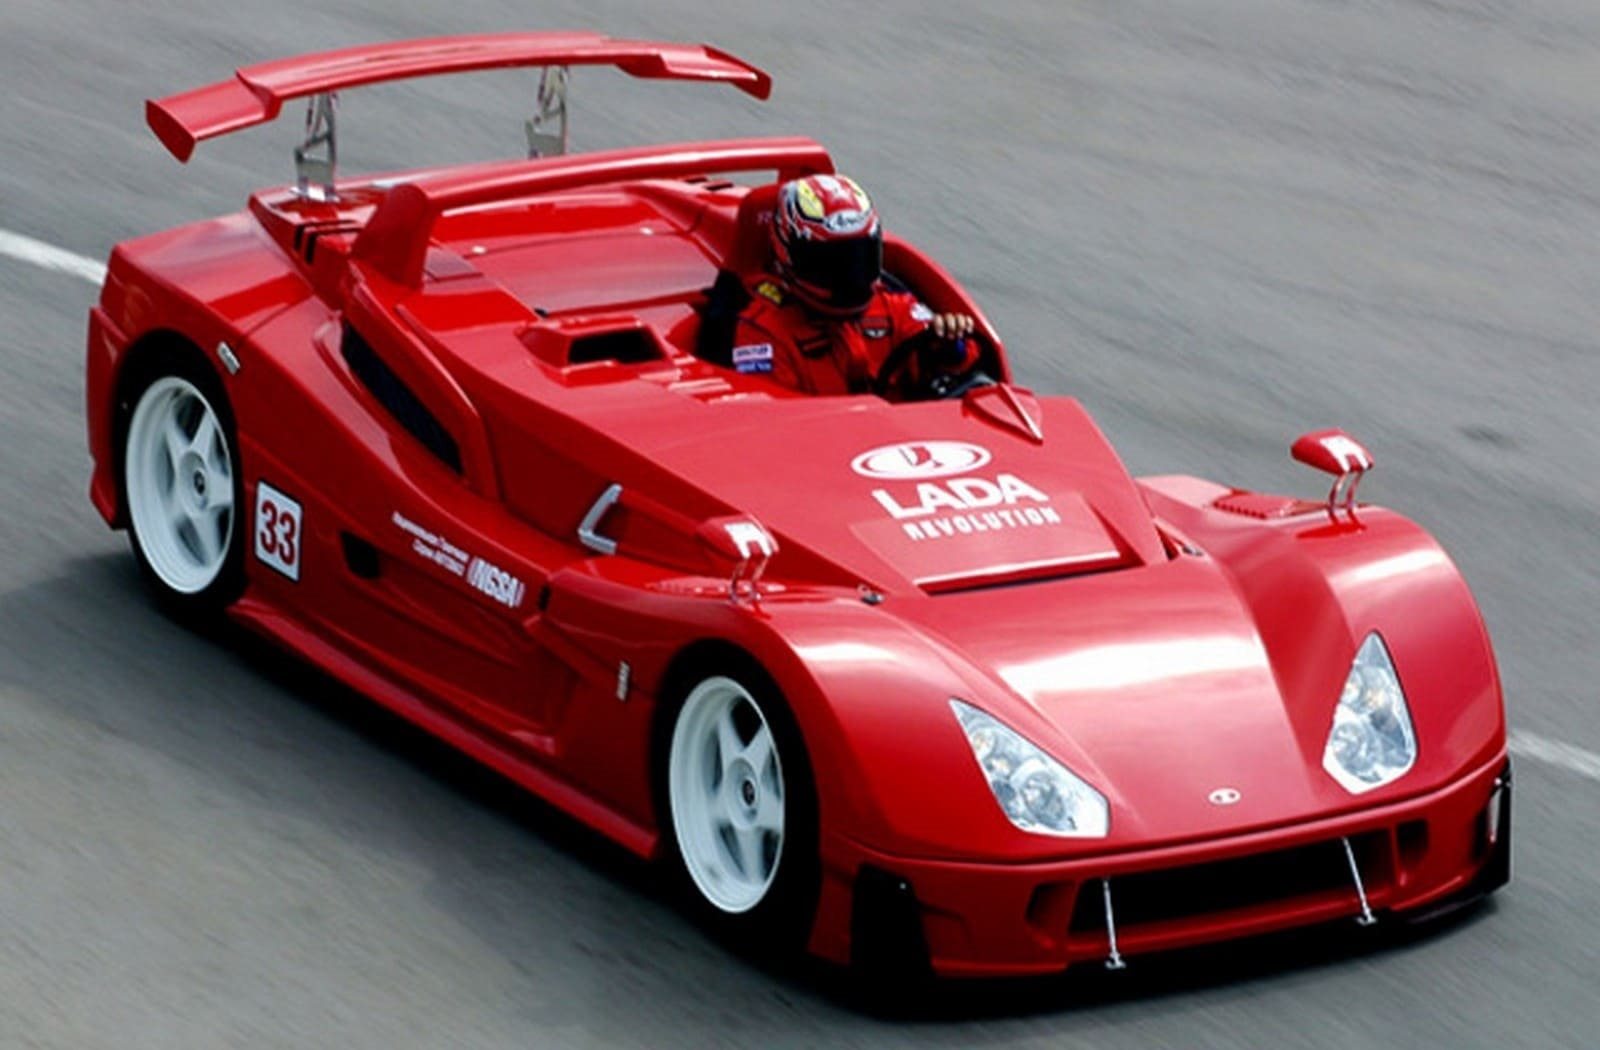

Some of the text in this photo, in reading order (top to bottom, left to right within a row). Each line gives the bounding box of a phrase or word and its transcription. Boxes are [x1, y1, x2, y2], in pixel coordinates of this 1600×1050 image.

[871, 473, 1049, 519] LADA
[260, 500, 296, 566] 33
[902, 507, 1061, 541] REVOLUTION
